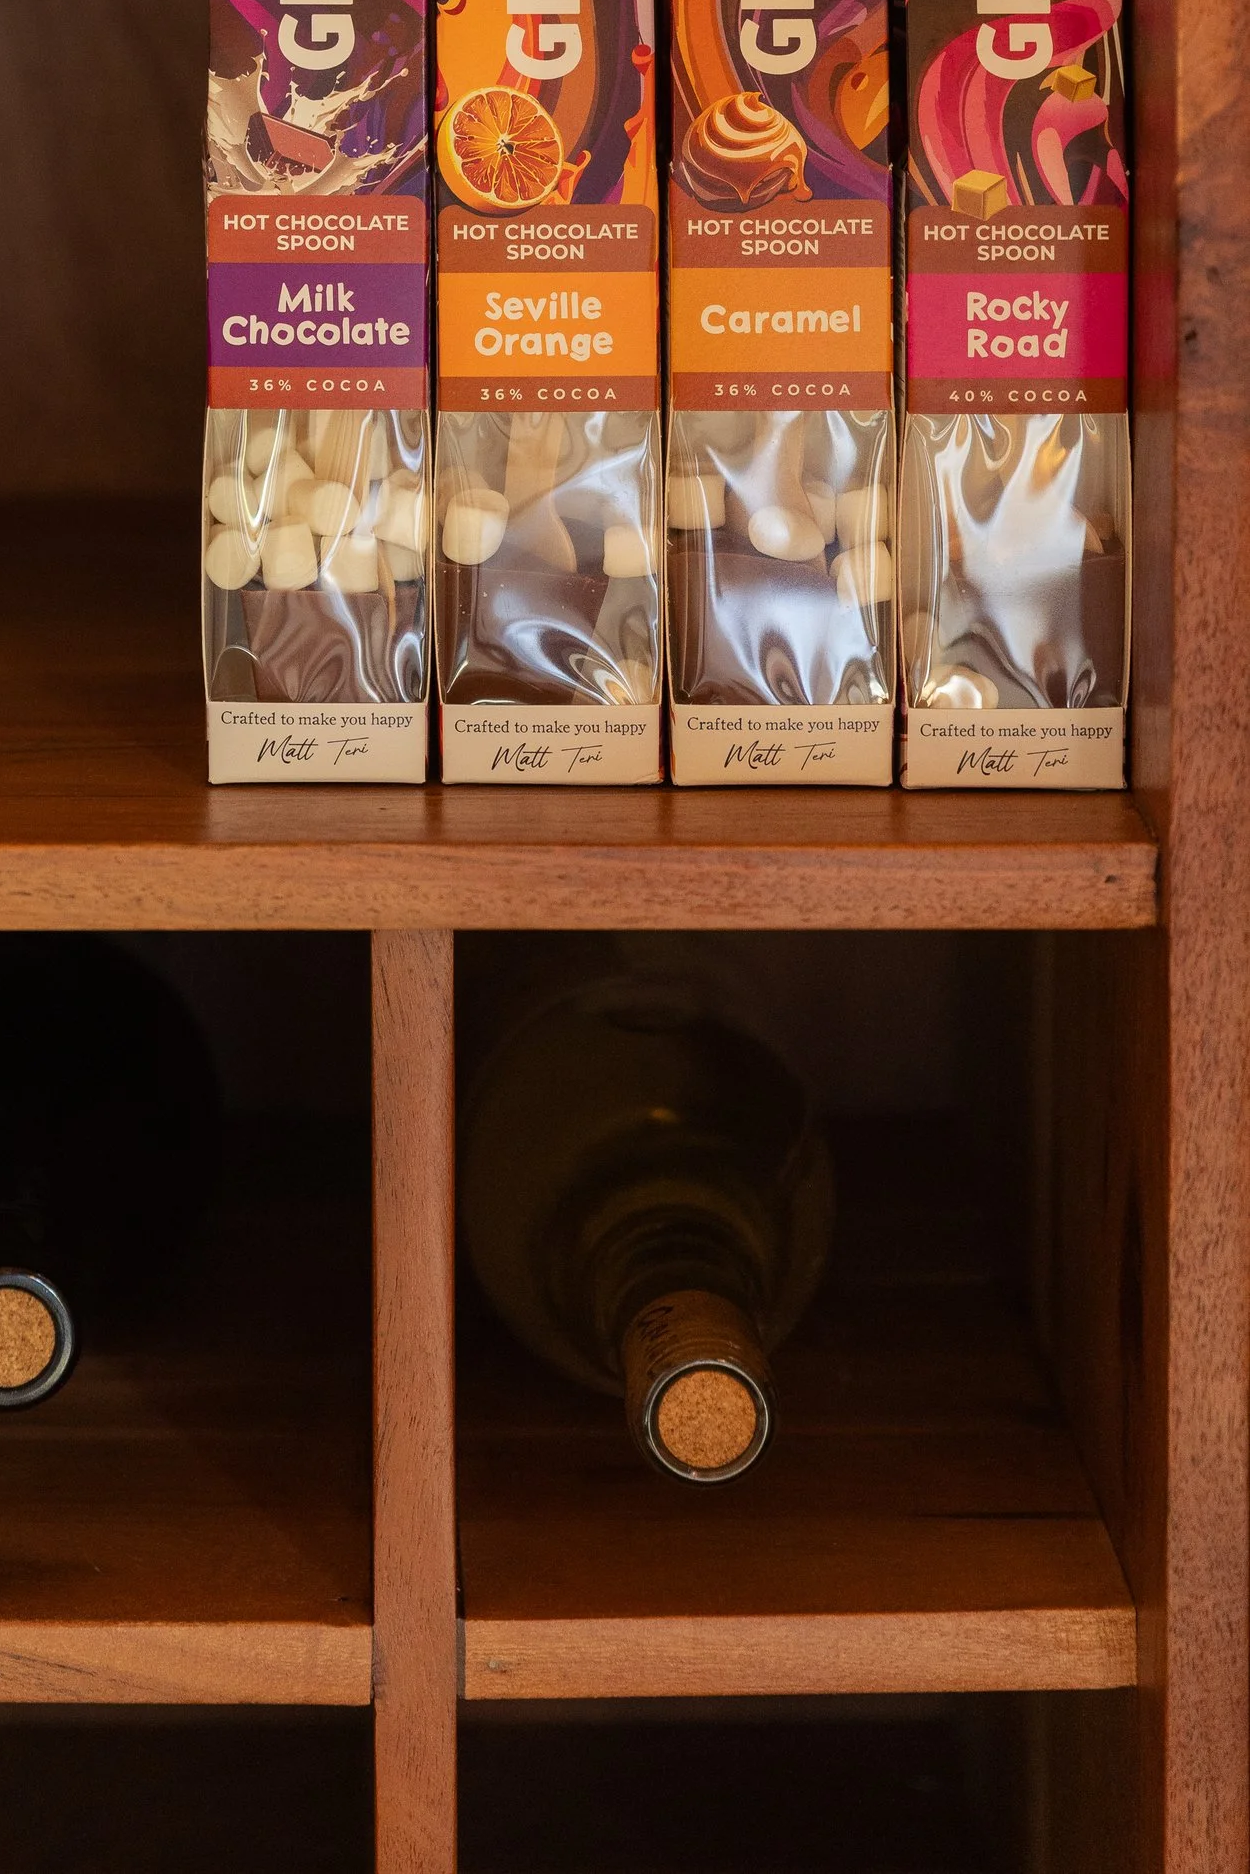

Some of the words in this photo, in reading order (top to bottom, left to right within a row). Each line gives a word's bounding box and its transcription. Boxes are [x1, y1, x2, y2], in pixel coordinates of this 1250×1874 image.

[224, 214, 270, 231] HOT
[275, 215, 409, 231] CHOCOLATE
[687, 219, 733, 236] HOT
[739, 219, 873, 235] CHOCOLATE
[453, 224, 499, 240] HOT
[504, 224, 638, 240] CHOCOLATE
[923, 225, 970, 241] HOT
[975, 225, 1110, 241] CHOCOLATE
[277, 235, 355, 251] SPOON
[741, 239, 819, 255] SPOON
[506, 244, 584, 260] SPOON
[977, 245, 1055, 261] SPOON
[278, 282, 355, 313] Milk
[485, 292, 602, 321] Seville
[967, 290, 1069, 329] Rocky
[700, 304, 861, 335] Caramel
[222, 315, 410, 346] Chocolate
[474, 327, 614, 362] Orange
[967, 328, 1068, 358] Road
[250, 380, 292, 391] 36%
[306, 380, 386, 391] COCOA
[714, 384, 757, 396] 36%
[771, 384, 851, 396] COCOA
[480, 388, 523, 401] 36%
[537, 388, 617, 400] COCOA
[949, 390, 993, 402] 40%
[1008, 390, 1087, 402] COCOA
[221, 711, 276, 726] Crafted
[281, 714, 295, 726] to
[298, 713, 337, 726] make
[341, 716, 367, 728] you
[371, 713, 414, 728] happy
[454, 719, 510, 733] Crafted
[514, 722, 529, 733] to
[532, 720, 571, 733] make
[574, 723, 600, 736] you
[604, 720, 647, 736] happy
[687, 716, 743, 731] Crafted
[748, 719, 762, 731] to
[765, 718, 804, 731] make
[807, 721, 833, 734] you
[838, 718, 880, 733] happy
[920, 723, 976, 737] Crafted
[981, 726, 994, 737] to
[998, 724, 1037, 737] make
[1040, 727, 1066, 740] you
[1071, 724, 1113, 739] happy
[257, 734, 319, 764] Matt
[491, 742, 553, 772] Matt
[724, 740, 786, 769] Matt
[956, 746, 1018, 775] Matt
